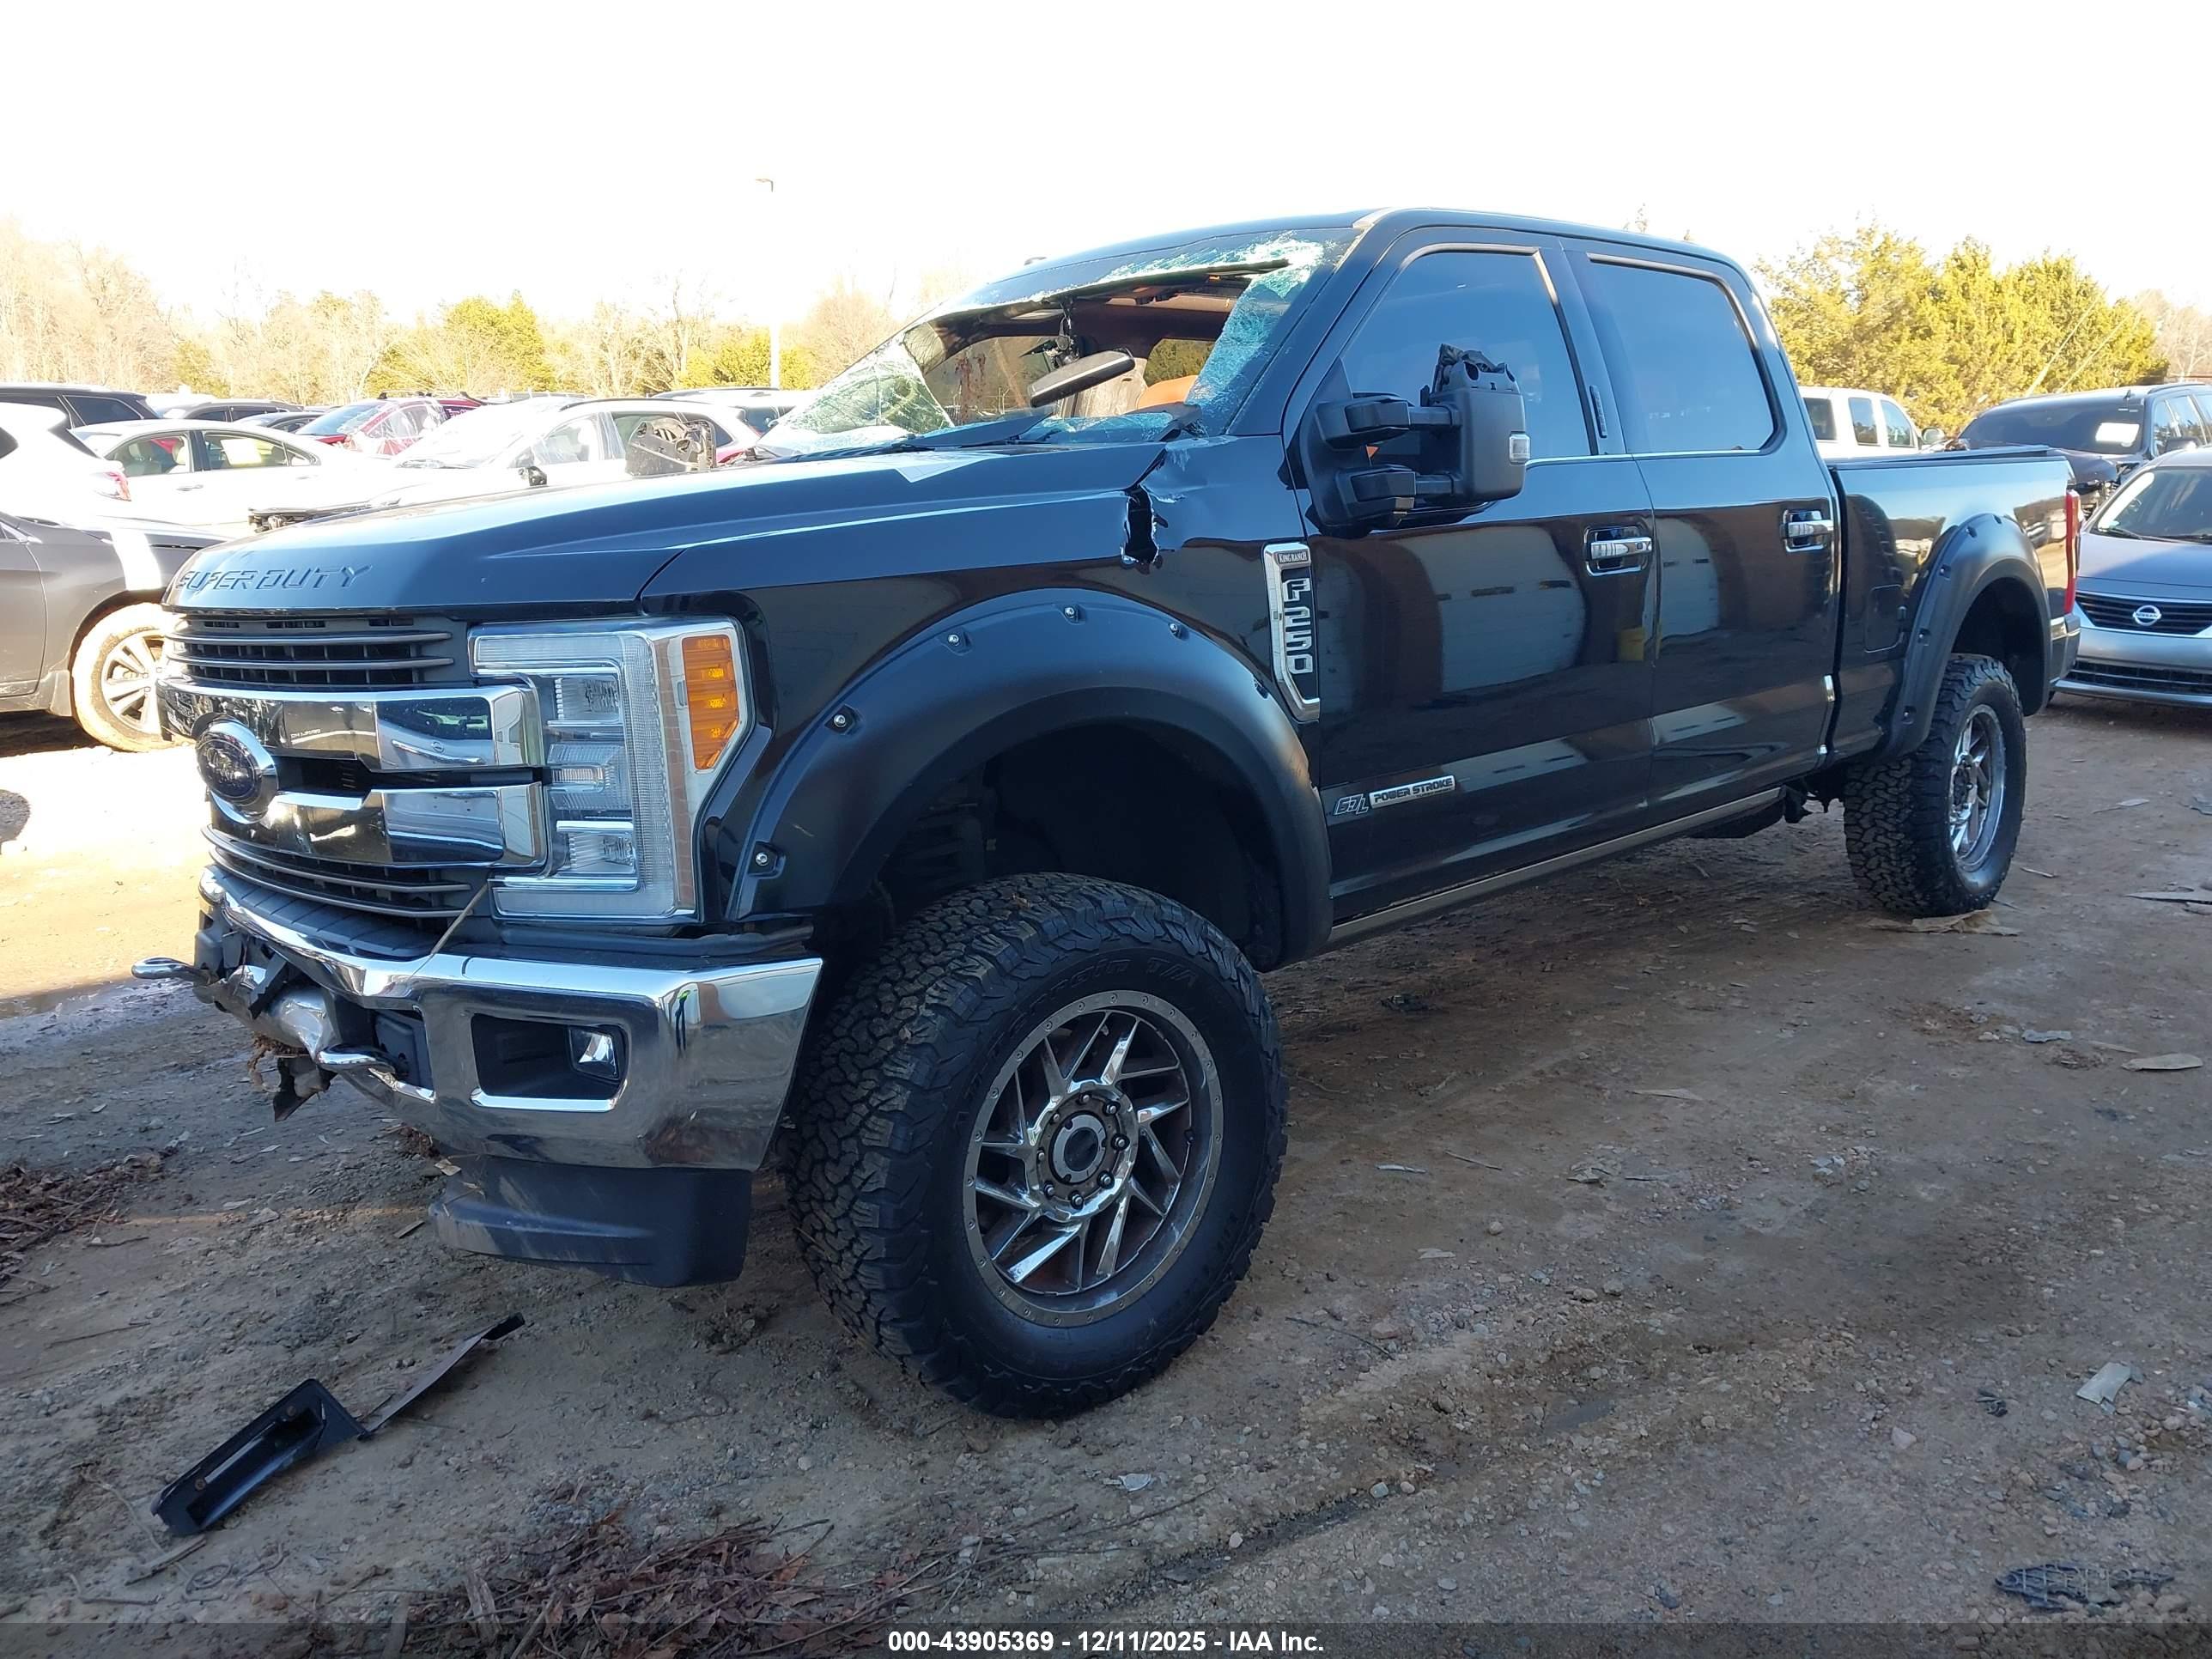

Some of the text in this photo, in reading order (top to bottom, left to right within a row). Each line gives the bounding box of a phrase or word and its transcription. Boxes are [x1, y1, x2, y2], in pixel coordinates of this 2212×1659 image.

[1279, 551, 1307, 563] KING RANCH
[176, 564, 373, 591] SUPER DUTY
[1283, 578, 1314, 674] F250
[1374, 788, 1411, 804] POWER
[1413, 778, 1453, 795] STROKE
